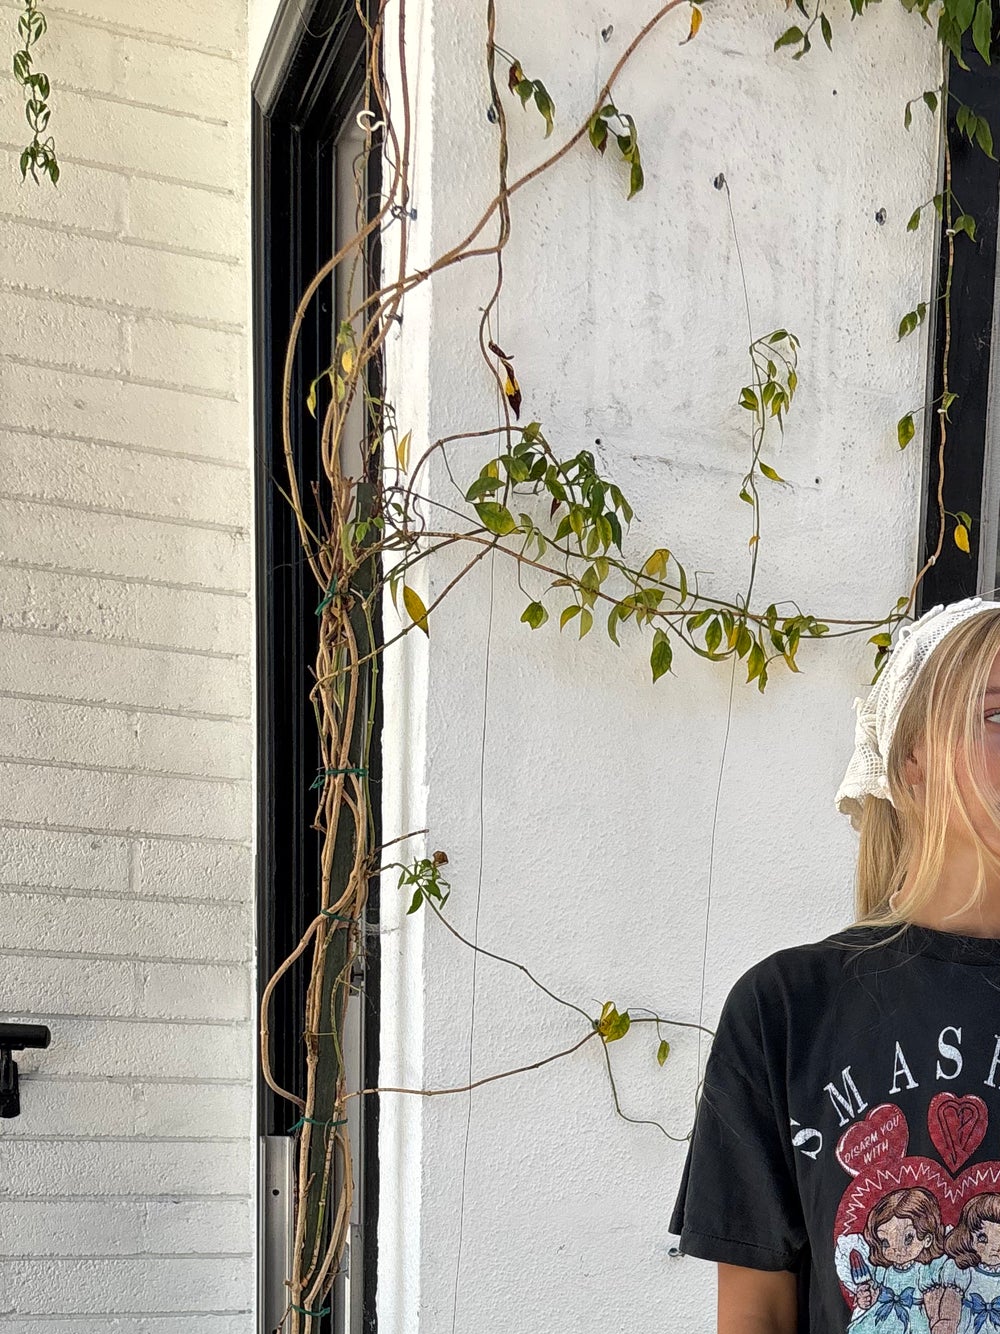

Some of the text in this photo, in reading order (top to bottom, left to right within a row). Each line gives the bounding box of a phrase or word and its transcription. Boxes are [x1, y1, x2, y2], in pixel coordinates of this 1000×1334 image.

[844, 1115, 899, 1163] DISARM YOU
[863, 1138, 889, 1165] WITH
